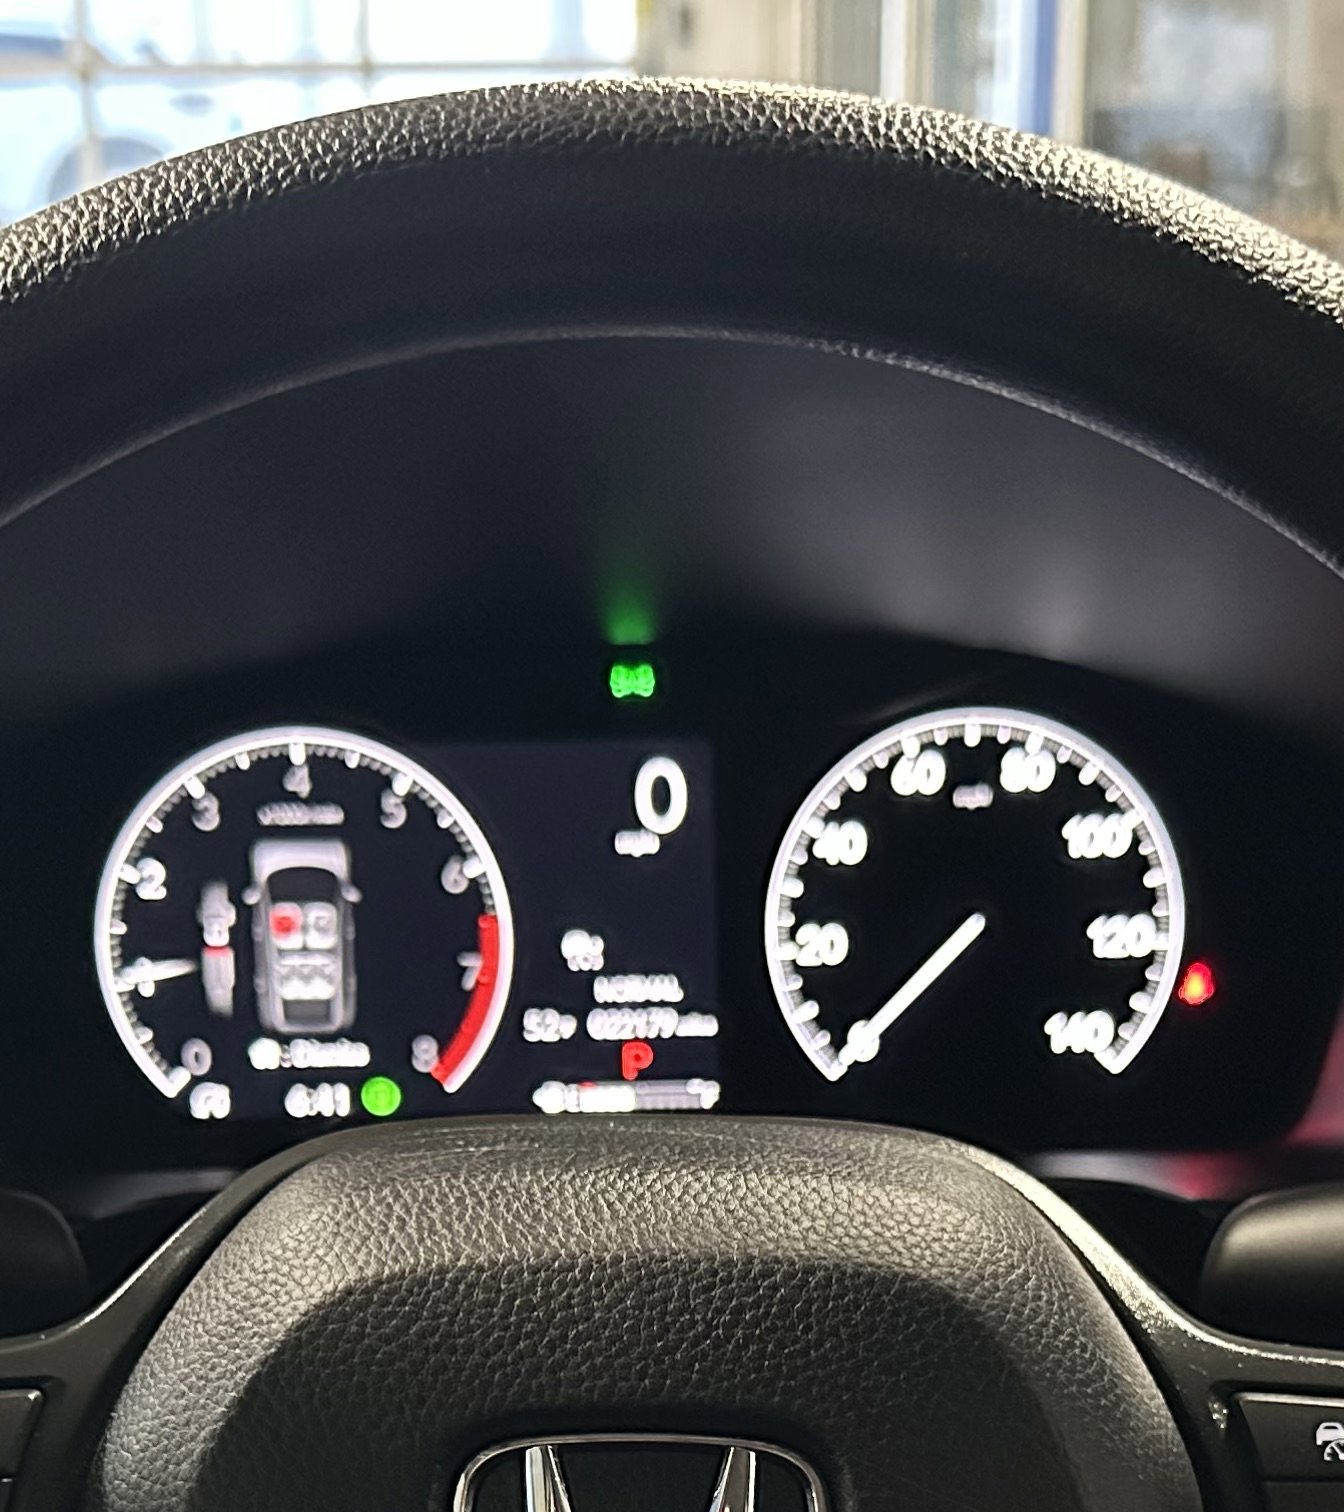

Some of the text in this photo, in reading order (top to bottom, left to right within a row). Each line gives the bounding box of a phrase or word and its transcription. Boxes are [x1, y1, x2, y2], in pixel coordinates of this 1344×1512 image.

[890, 748, 947, 797] 60
[999, 746, 1057, 794] 80
[632, 754, 689, 836] 0
[812, 819, 869, 867] 40
[1061, 812, 1134, 860] 100
[136, 858, 167, 900] 2
[794, 922, 850, 967] 20
[1086, 913, 1158, 960] 120
[1044, 1009, 1116, 1055] 140
[180, 1037, 213, 1077] 0
[620, 1040, 655, 1082] P
